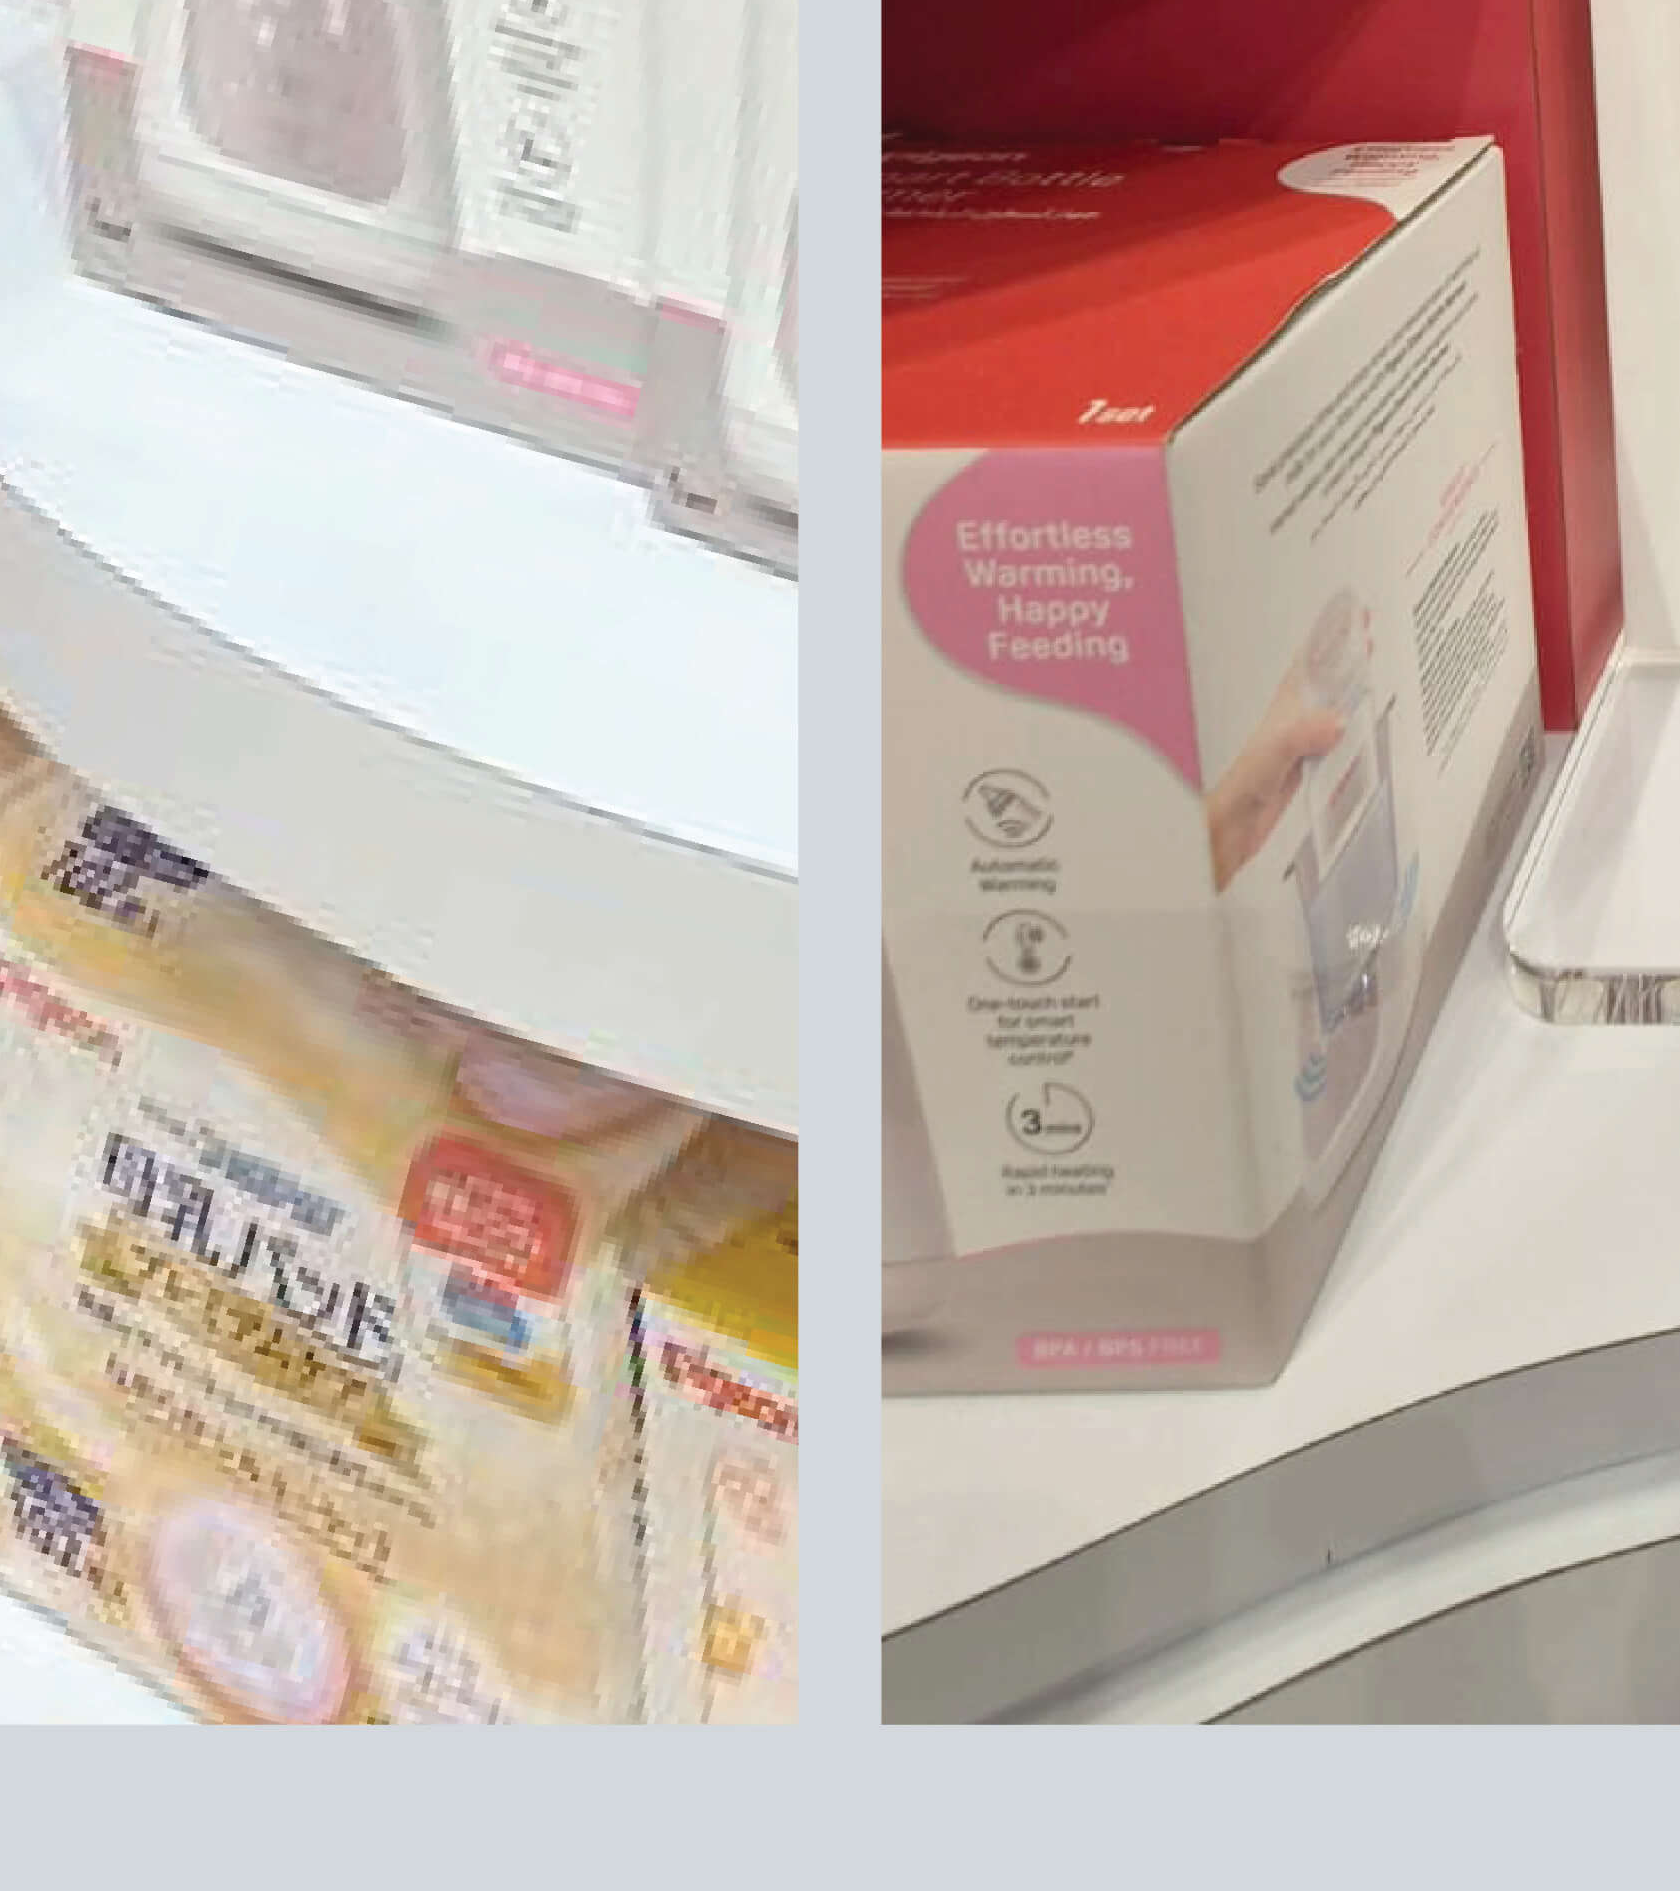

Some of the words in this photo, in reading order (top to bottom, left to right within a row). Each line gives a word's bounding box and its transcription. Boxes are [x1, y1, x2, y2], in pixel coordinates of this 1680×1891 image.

[955, 520, 1134, 553] Effortless
[962, 558, 1135, 591] Warming,
[997, 594, 1110, 629] Happy
[987, 630, 1130, 663] Feeding
[997, 1014, 1021, 1029] for
[1025, 1014, 1075, 1029] smart
[1020, 1108, 1042, 1136] 3
